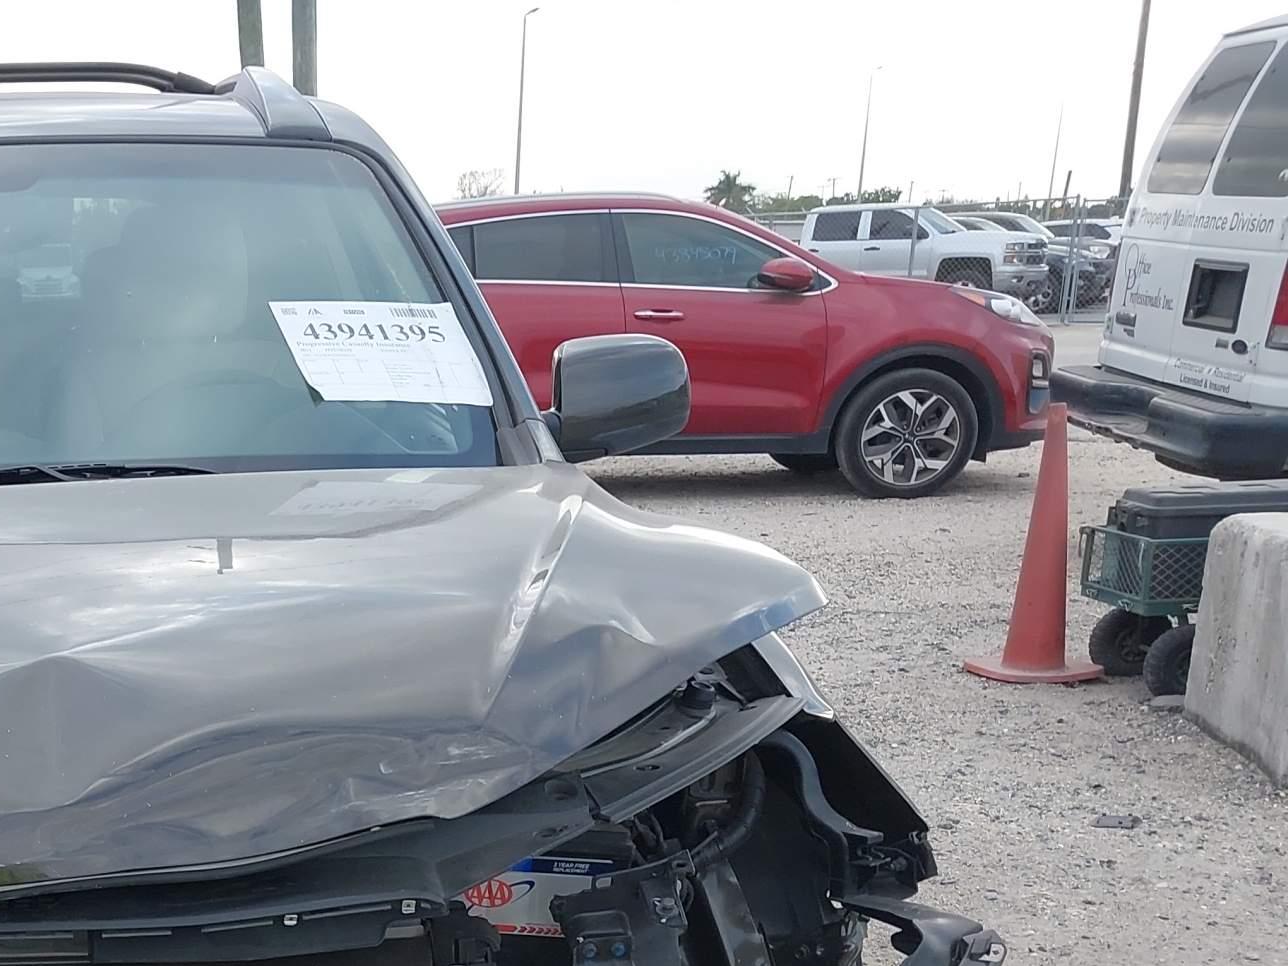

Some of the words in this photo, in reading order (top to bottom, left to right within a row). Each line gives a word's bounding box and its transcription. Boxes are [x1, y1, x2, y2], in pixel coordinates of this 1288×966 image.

[1139, 208, 1171, 231] Property
[1172, 209, 1228, 231] Maintenance
[1229, 212, 1275, 233] Division
[303, 322, 446, 343] 43941395
[1179, 372, 1204, 388] Licensed
[1209, 379, 1231, 394] Insured
[465, 879, 513, 907] AAA
